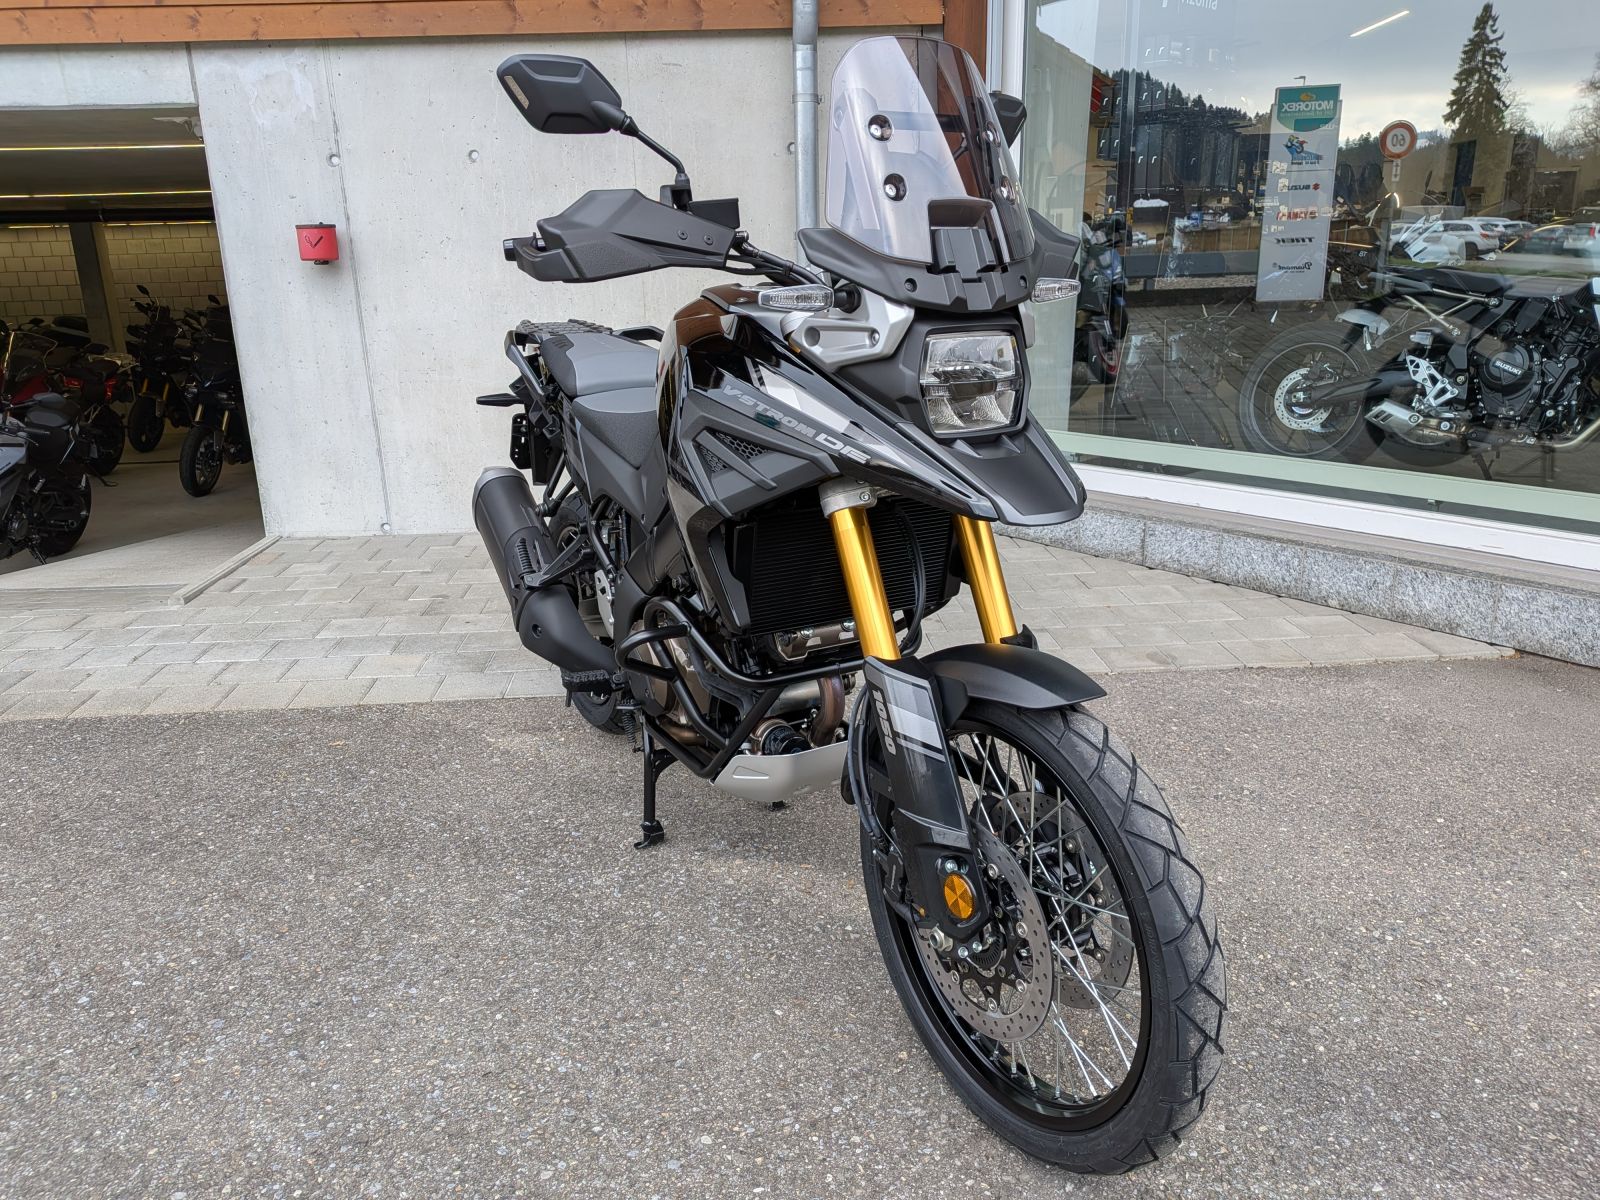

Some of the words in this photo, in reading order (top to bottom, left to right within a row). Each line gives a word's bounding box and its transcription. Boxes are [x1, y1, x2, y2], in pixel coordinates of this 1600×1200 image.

[1495, 360, 1522, 375] SUZUKI
[723, 385, 817, 438] V-STROM
[815, 433, 872, 464] DE
[872, 689, 897, 755] 1050
